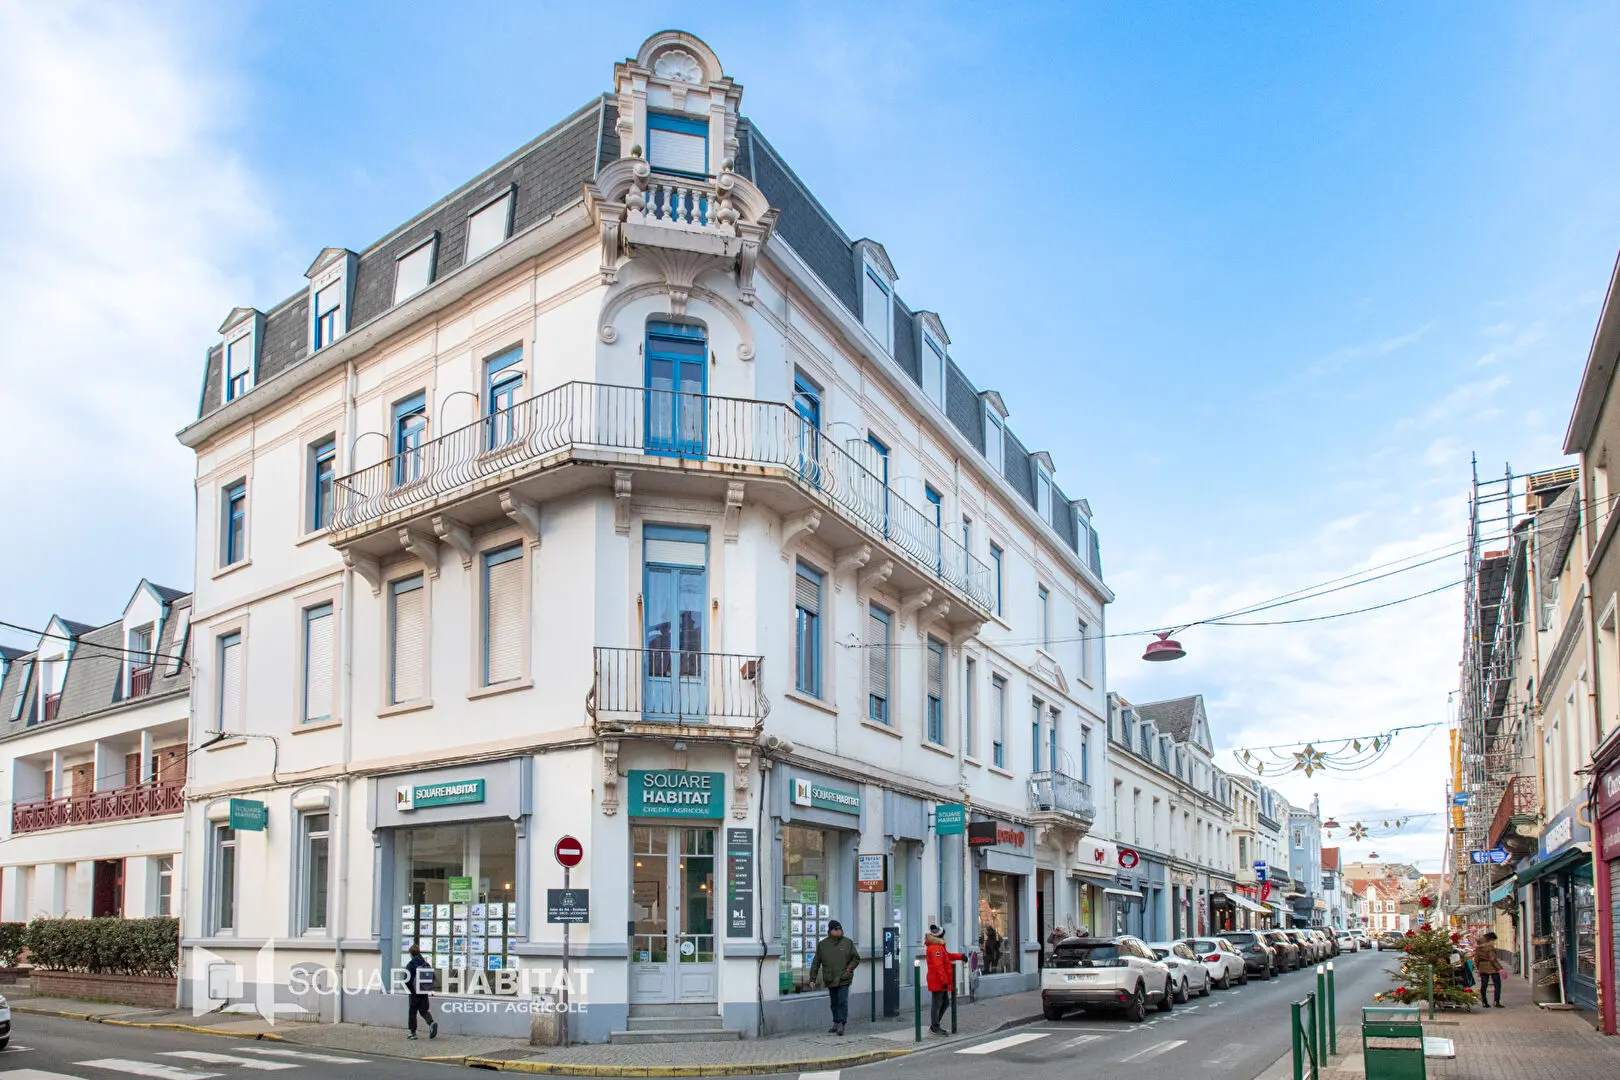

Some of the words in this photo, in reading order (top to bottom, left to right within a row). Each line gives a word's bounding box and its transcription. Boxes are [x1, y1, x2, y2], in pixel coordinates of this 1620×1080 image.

[643, 773, 711, 789] SQUARE
[643, 790, 711, 805] HABITAT
[885, 931, 892, 942] P
